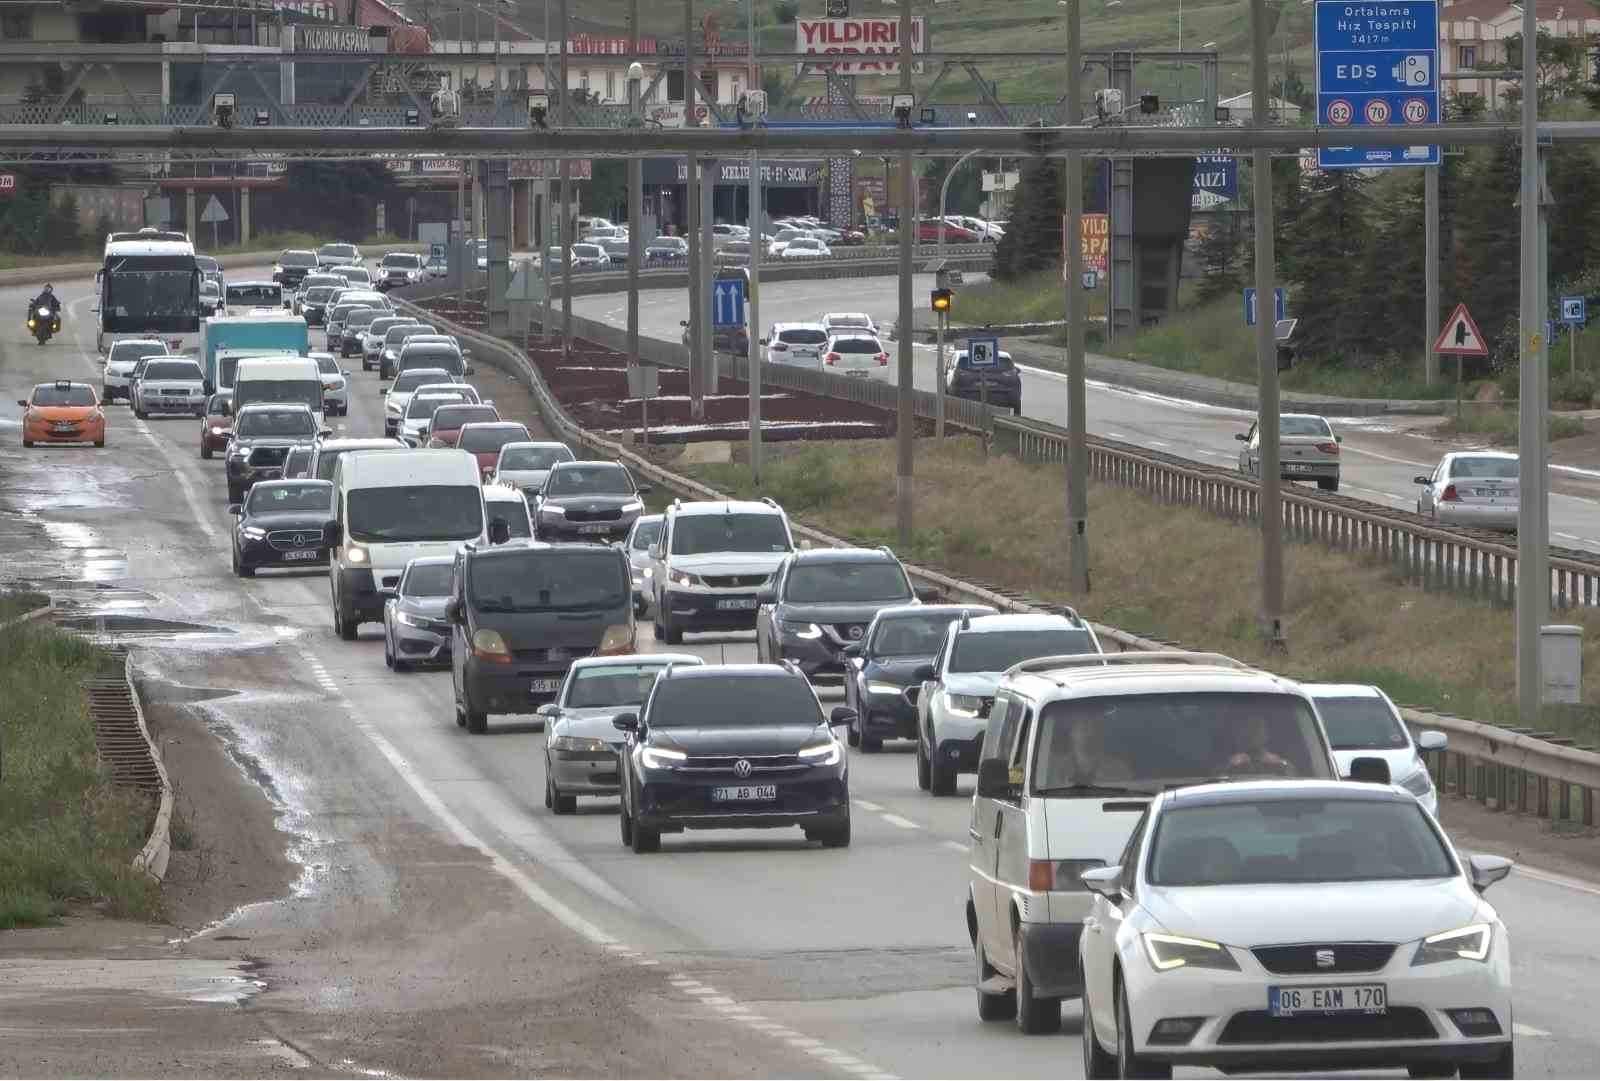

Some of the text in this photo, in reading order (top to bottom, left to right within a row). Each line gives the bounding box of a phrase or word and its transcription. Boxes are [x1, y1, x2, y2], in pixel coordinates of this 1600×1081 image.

[1344, 6, 1410, 16] Ortalama
[1367, 20, 1416, 32] Tespiti
[1336, 64, 1377, 79] EDS
[1333, 107, 1347, 119] 82
[1370, 106, 1385, 119] 70
[1409, 104, 1424, 118] 70
[1280, 990, 1302, 1009] 06
[1312, 989, 1344, 1008] EAM
[1354, 988, 1384, 1007] 170
